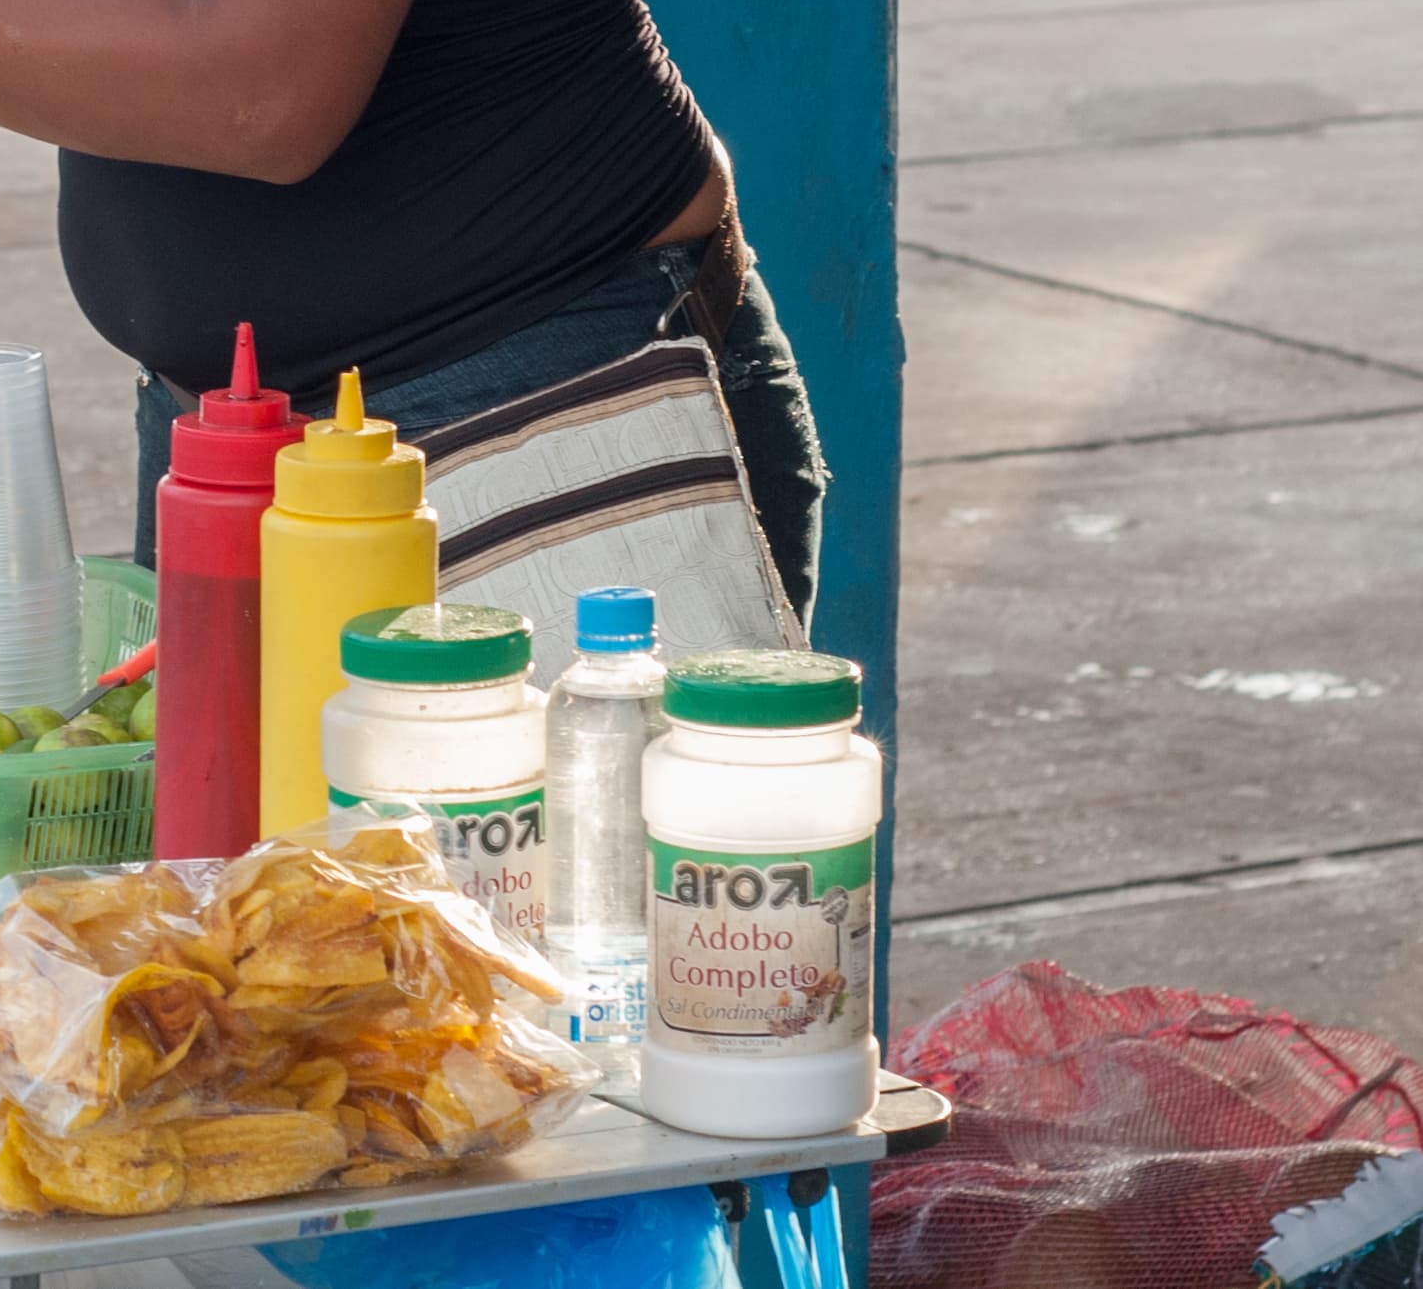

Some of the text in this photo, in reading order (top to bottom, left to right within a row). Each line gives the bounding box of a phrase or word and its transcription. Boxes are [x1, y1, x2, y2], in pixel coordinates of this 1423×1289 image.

[462, 867, 532, 898] dobo
[675, 861, 765, 910] aro
[687, 921, 794, 952] Adobo
[669, 956, 820, 999] Completo
[667, 997, 688, 1015] Sal
